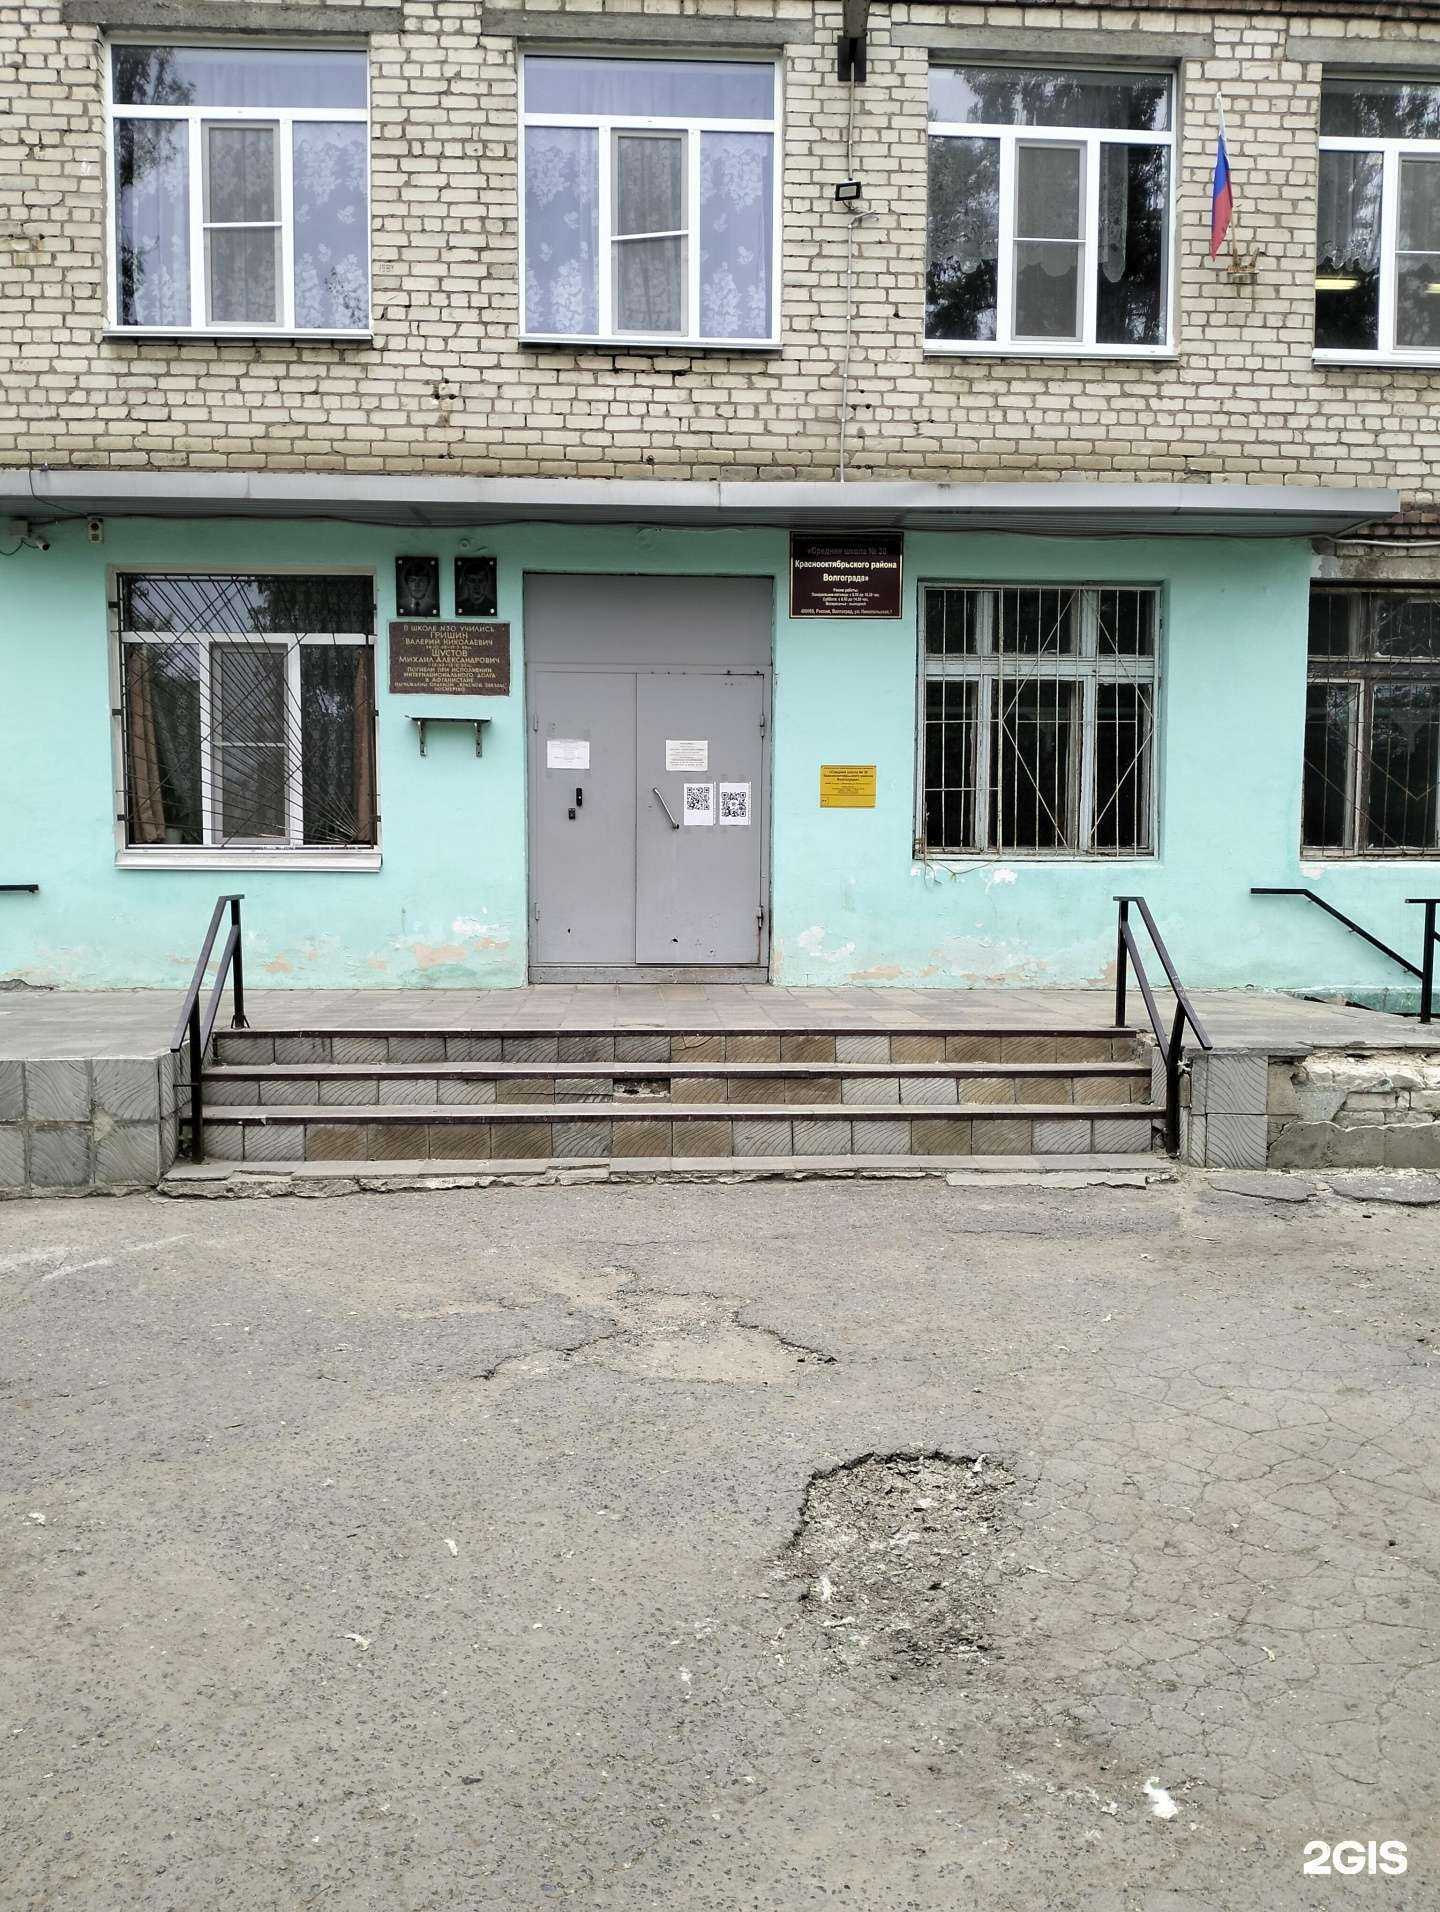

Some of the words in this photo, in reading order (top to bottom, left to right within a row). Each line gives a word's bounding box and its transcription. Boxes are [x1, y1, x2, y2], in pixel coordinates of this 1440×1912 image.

[795, 560, 870, 570] Краснооктябрьского
[871, 561, 897, 570] района
[823, 573, 869, 583] Волгограда»
[410, 624, 437, 632] ШКОЛЕ
[459, 625, 495, 633] УЧИЛИСЬ
[430, 631, 469, 639] ГРИШИН
[443, 638, 493, 646] НИКОЛАЕВИЧ
[431, 649, 468, 657] ШУСТОВ
[435, 656, 500, 664] АЛЕКСАНДРОВИЧ
